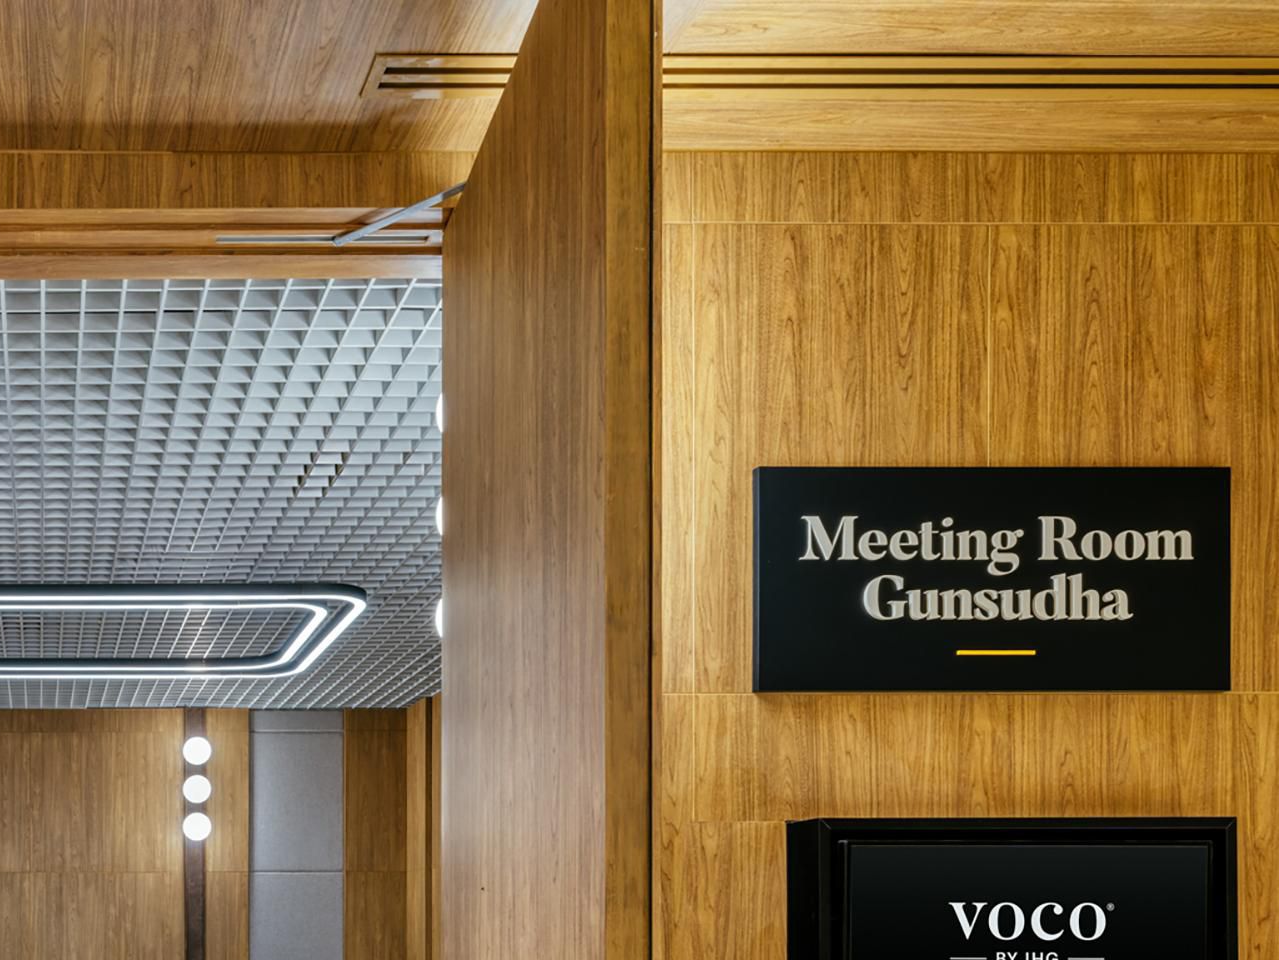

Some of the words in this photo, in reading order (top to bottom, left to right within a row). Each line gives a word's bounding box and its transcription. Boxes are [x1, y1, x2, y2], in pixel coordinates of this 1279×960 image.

[799, 515, 1024, 576] Meeting
[1037, 515, 1195, 561] Room
[862, 573, 1134, 621] Gunsudha
